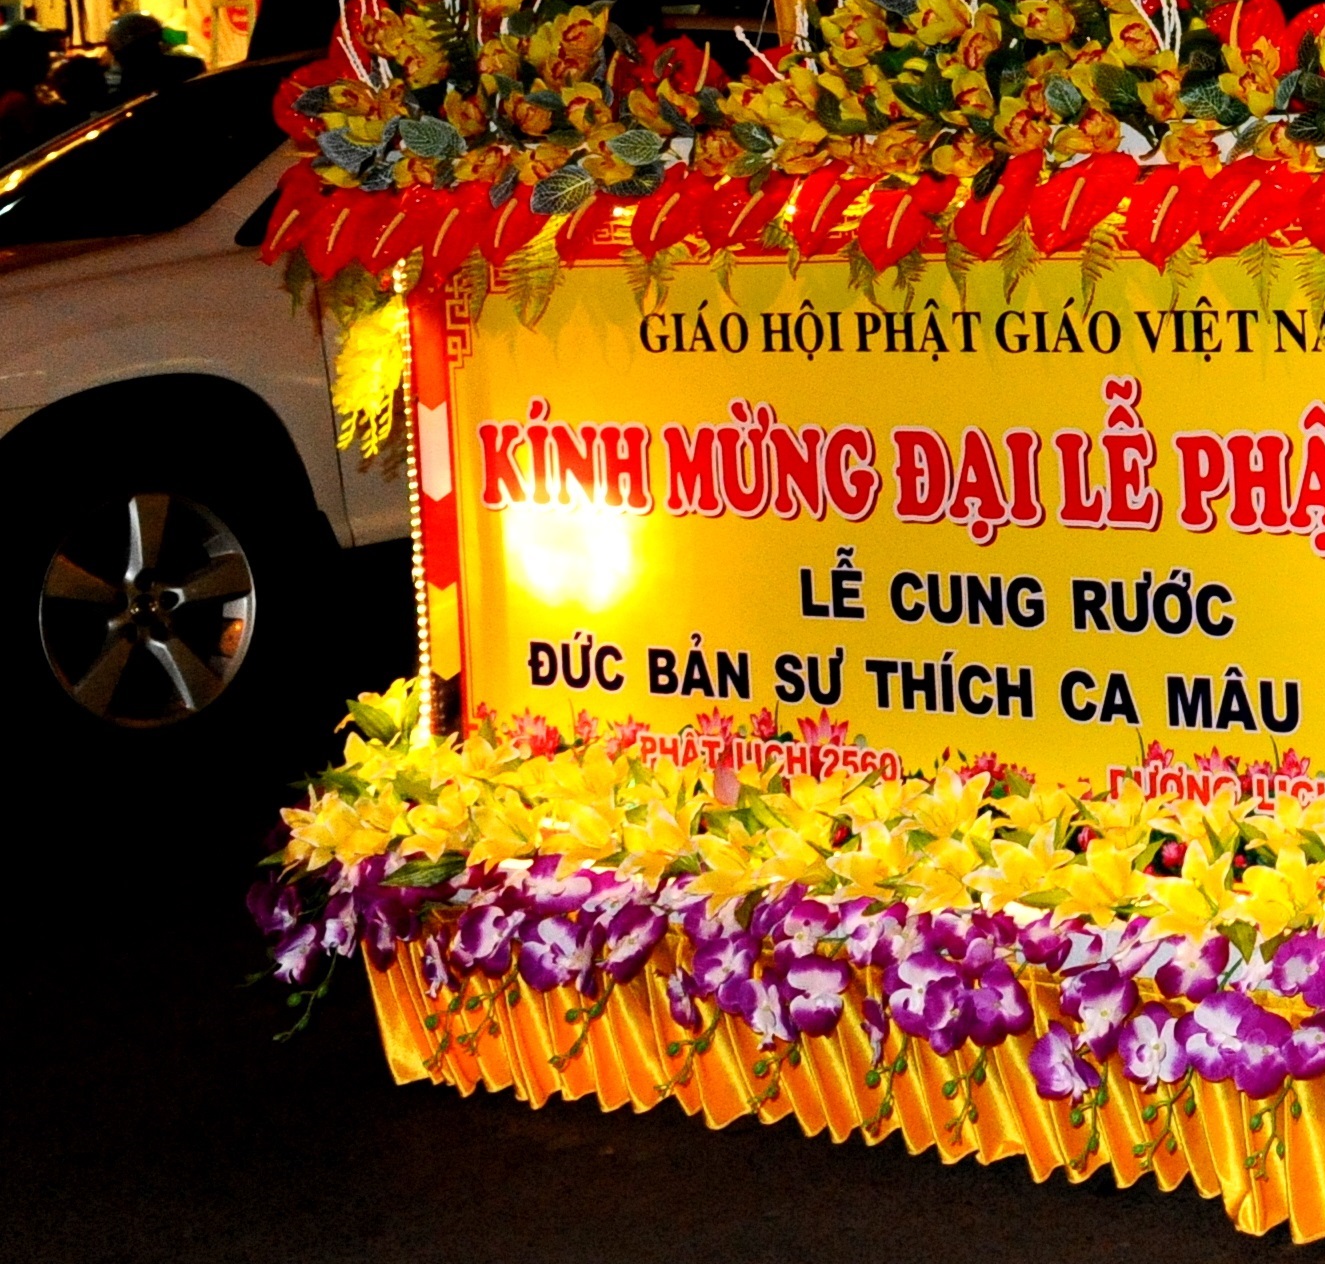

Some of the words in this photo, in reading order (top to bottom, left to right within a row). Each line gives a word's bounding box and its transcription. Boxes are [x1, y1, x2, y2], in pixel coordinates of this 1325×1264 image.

[640, 300, 748, 353] GIÁO
[762, 298, 842, 362] HỘI
[856, 298, 982, 363] PHẬT
[995, 297, 1120, 354] GIÁO
[1136, 295, 1258, 363] VIỆT
[476, 395, 653, 515] KÍNH
[661, 397, 880, 521] MỪNG
[894, 425, 1045, 545] ĐẠI
[1057, 375, 1161, 531] LỄ
[799, 546, 866, 620] LỄ
[890, 570, 1045, 630] CUNG
[1071, 568, 1236, 637] RƯỚC
[527, 630, 625, 692] ĐỨC
[647, 633, 751, 701] BẢN
[774, 646, 844, 706] SƯ
[866, 650, 1034, 719] THÍCH
[1060, 668, 1139, 726] CA
[1166, 667, 1301, 736] MÂU
